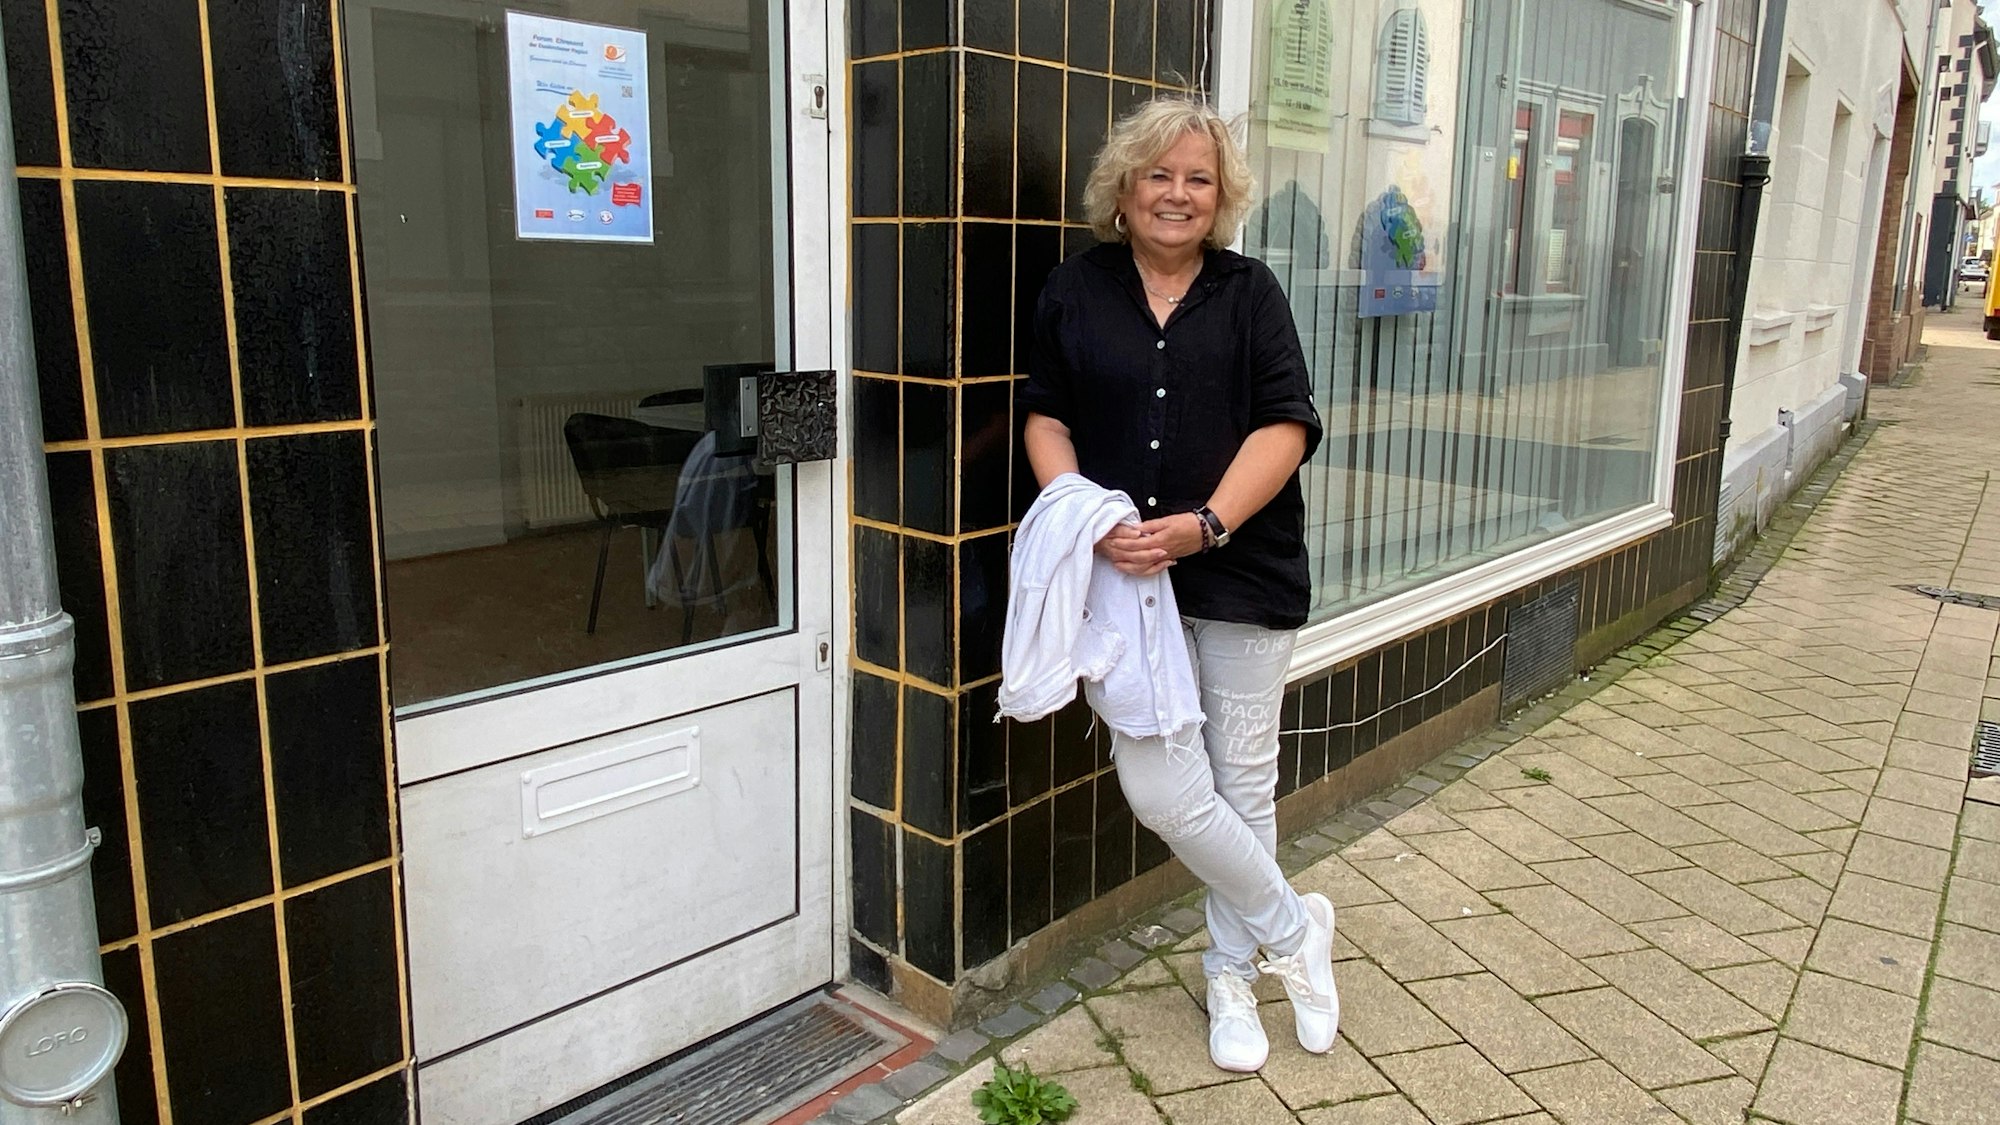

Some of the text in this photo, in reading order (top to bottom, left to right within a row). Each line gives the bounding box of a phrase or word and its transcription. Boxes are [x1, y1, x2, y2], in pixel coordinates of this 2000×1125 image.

[1244, 638, 1268, 654] TO
[1220, 699, 1271, 720] BACK
[1223, 715, 1267, 737] I AM
[1226, 736, 1264, 753] THE
[24, 1026, 88, 1057] LORO
